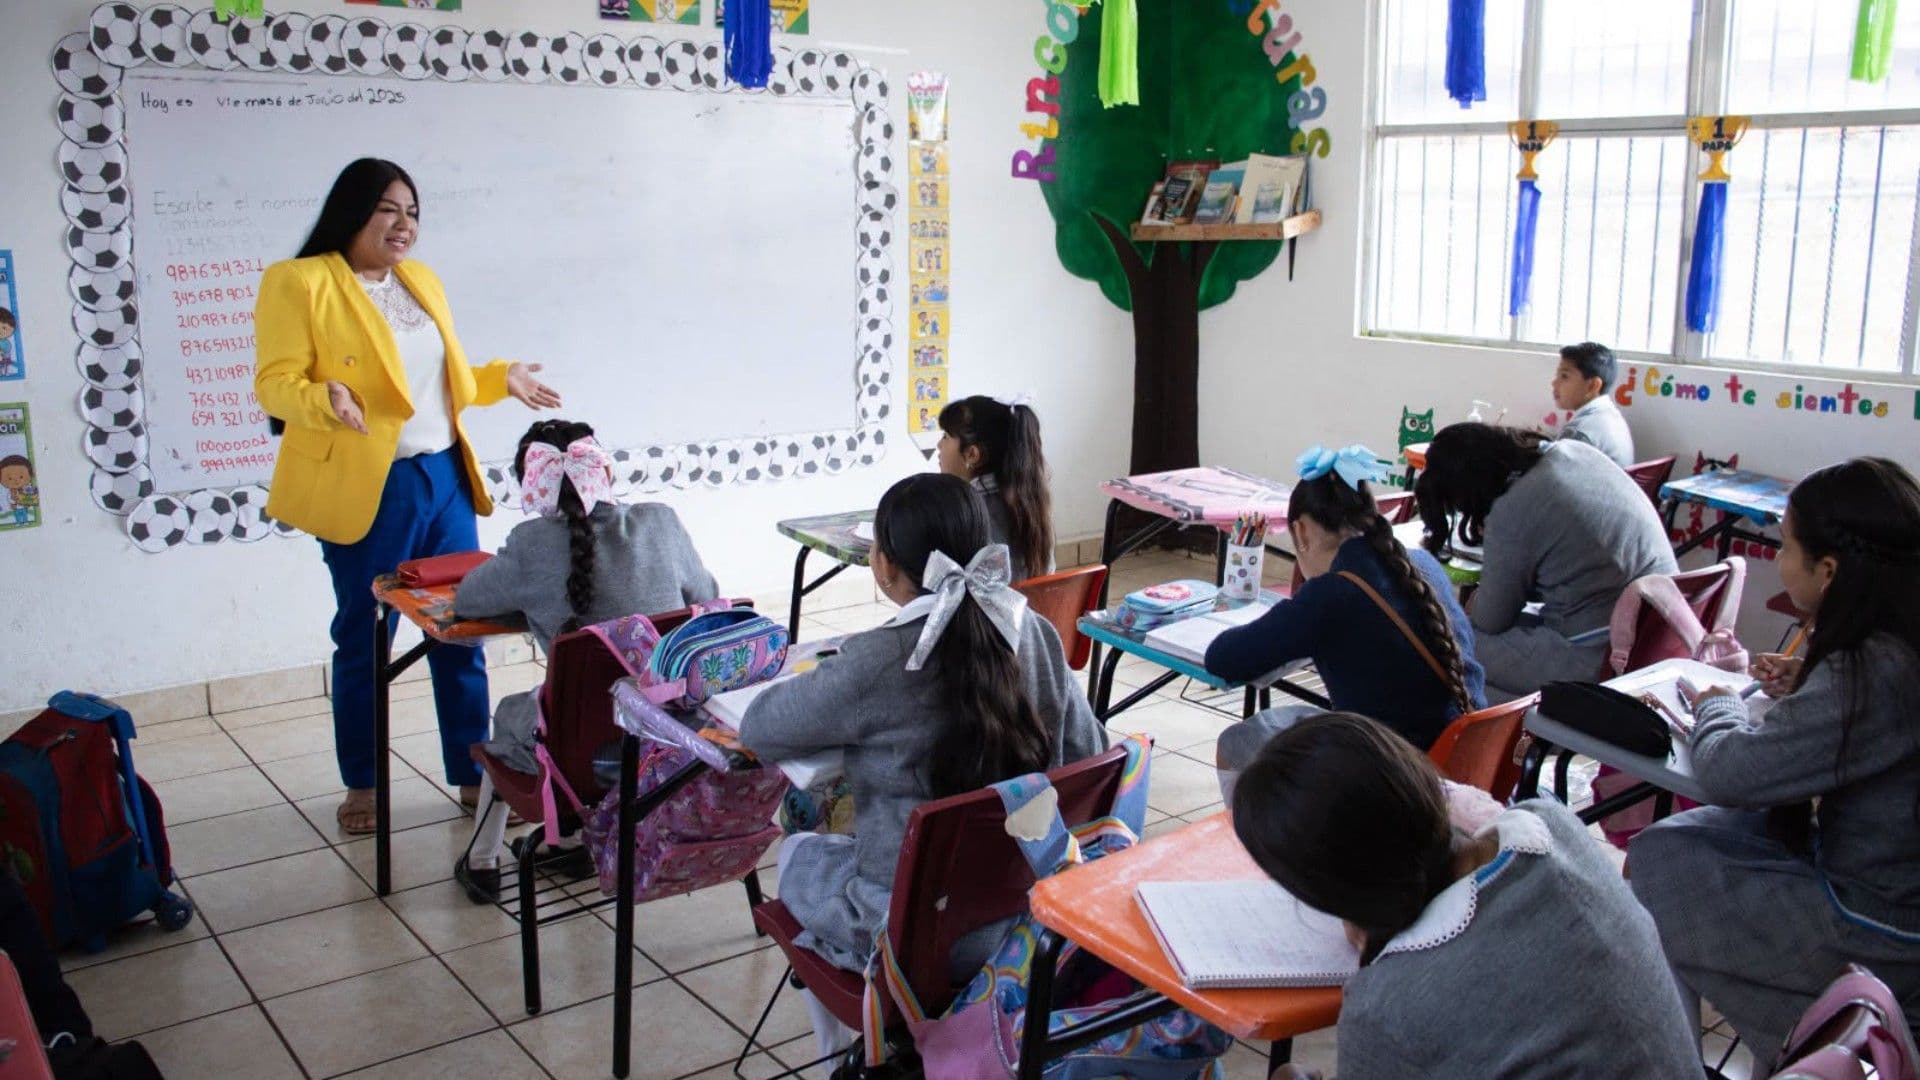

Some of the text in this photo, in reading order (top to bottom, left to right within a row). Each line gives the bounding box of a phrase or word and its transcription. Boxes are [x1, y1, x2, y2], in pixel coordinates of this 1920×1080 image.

[1011, 0, 1089, 181] Rincó
[1229, 0, 1331, 159] turas
[141, 92, 169, 113] Hoy
[176, 99, 193, 107] es
[288, 94, 302, 106] de
[367, 88, 404, 105] 2025
[1527, 121, 1537, 140] 1
[1712, 117, 1725, 139] 1
[153, 189, 214, 216] Escribe
[166, 259, 264, 282] 987654321
[1725, 374, 1756, 405] te
[1776, 383, 1889, 417] sientes
